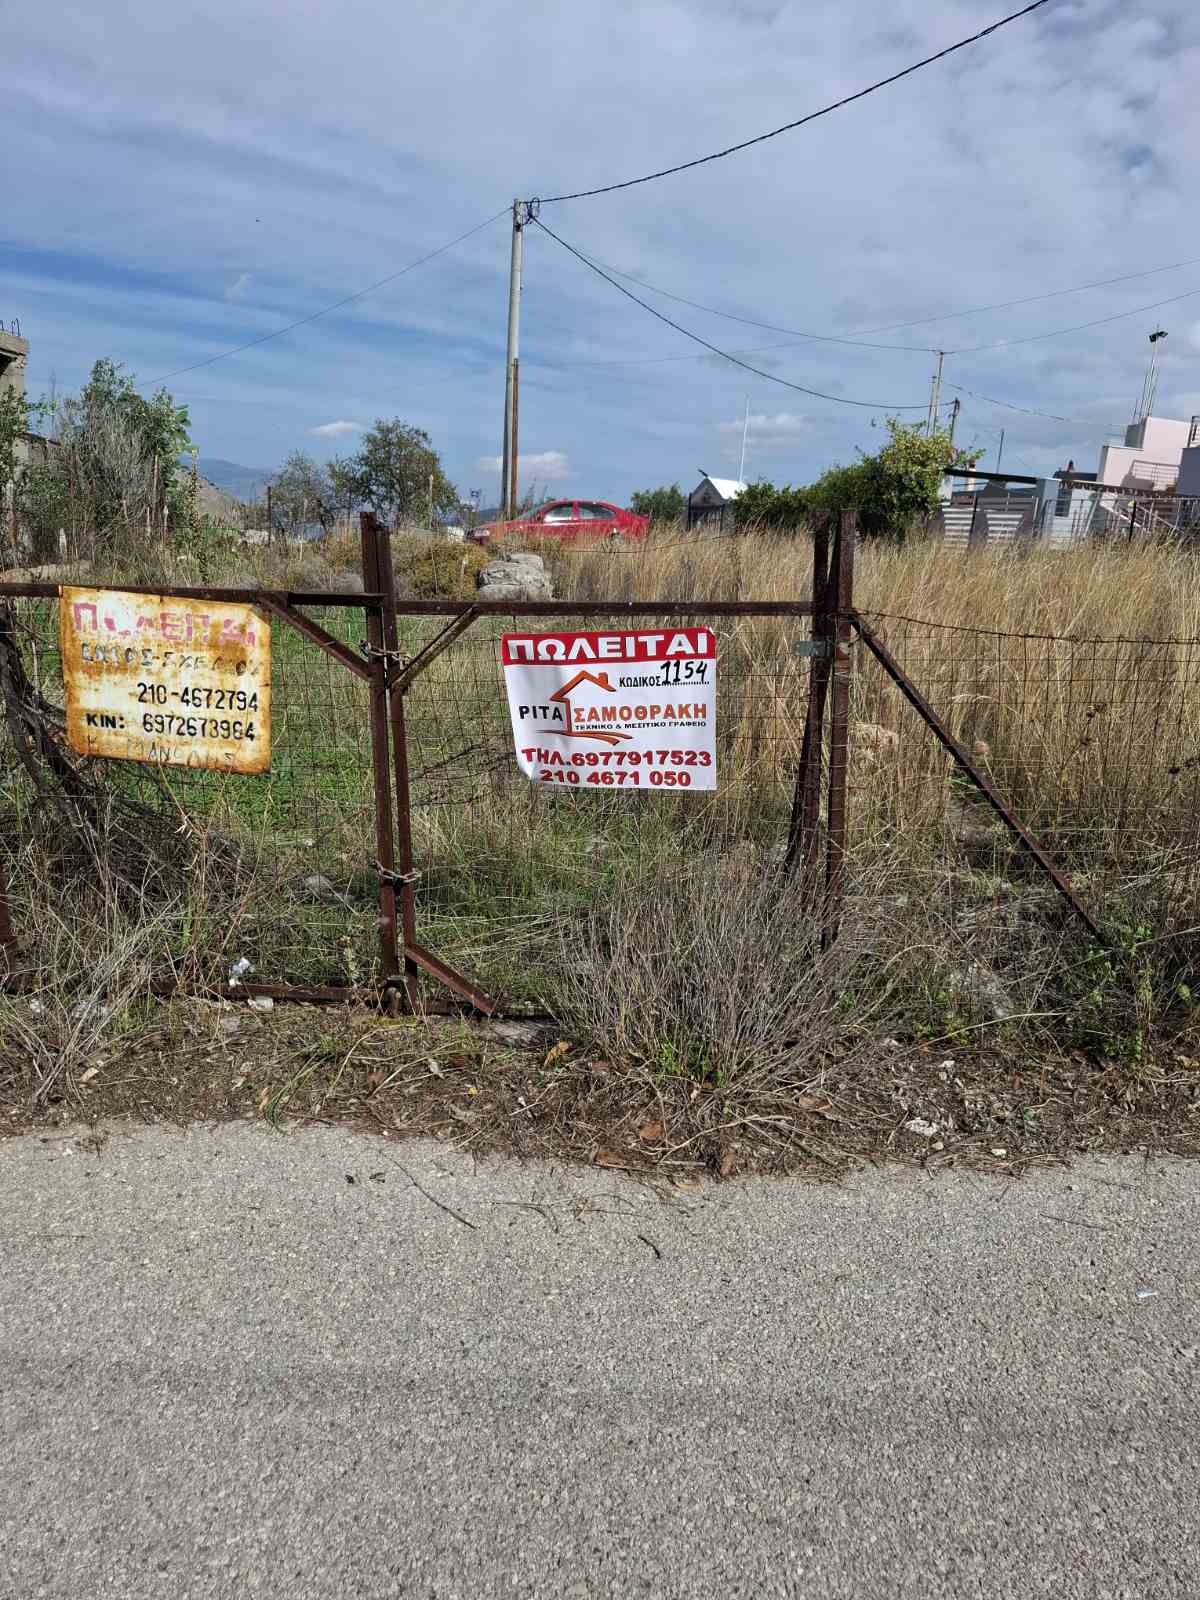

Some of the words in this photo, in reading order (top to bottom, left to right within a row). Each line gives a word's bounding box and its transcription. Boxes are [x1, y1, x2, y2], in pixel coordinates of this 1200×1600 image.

[507, 633, 709, 661] ΠΩΛΕΙΤΑΙ
[136, 682, 258, 712] 210-4672794
[86, 713, 125, 729] ΚΙΝ:
[518, 705, 564, 722] ΡΙΤΑ
[573, 703, 707, 723] ΣΑΜΟΘΡΑΚΗ
[540, 769, 580, 784] 210
[586, 771, 640, 786] 4671
[649, 771, 691, 786] 050
